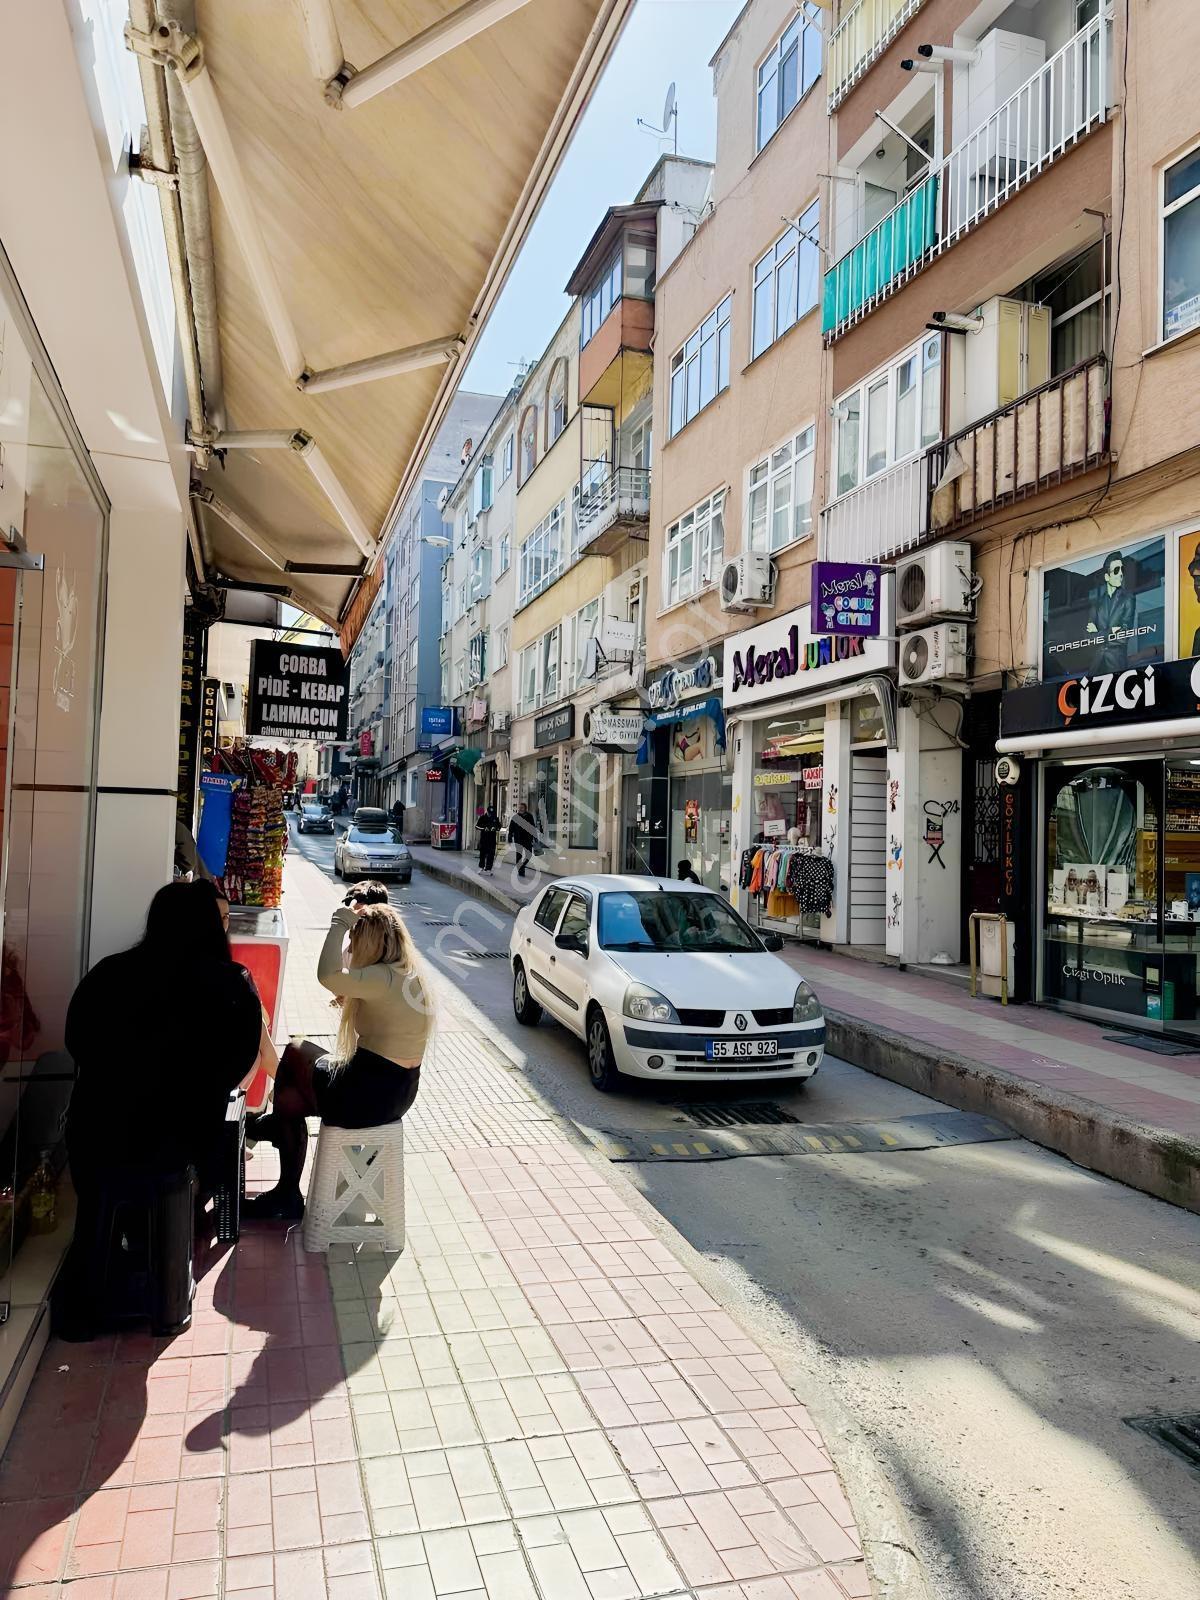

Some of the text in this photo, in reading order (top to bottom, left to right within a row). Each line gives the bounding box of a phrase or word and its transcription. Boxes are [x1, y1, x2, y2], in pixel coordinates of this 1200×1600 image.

[821, 573, 863, 598] Meral
[1048, 624, 1157, 654] PORSCHE DESIGN
[279, 653, 327, 676] ÇORBA
[732, 625, 799, 692] Meral
[258, 674, 290, 698] PİDE
[301, 681, 345, 703] KEBAP
[203, 687, 215, 738] ÇORBA
[261, 703, 339, 727] LAHMACUN
[713, 1041, 776, 1056] 55 ASC 923
